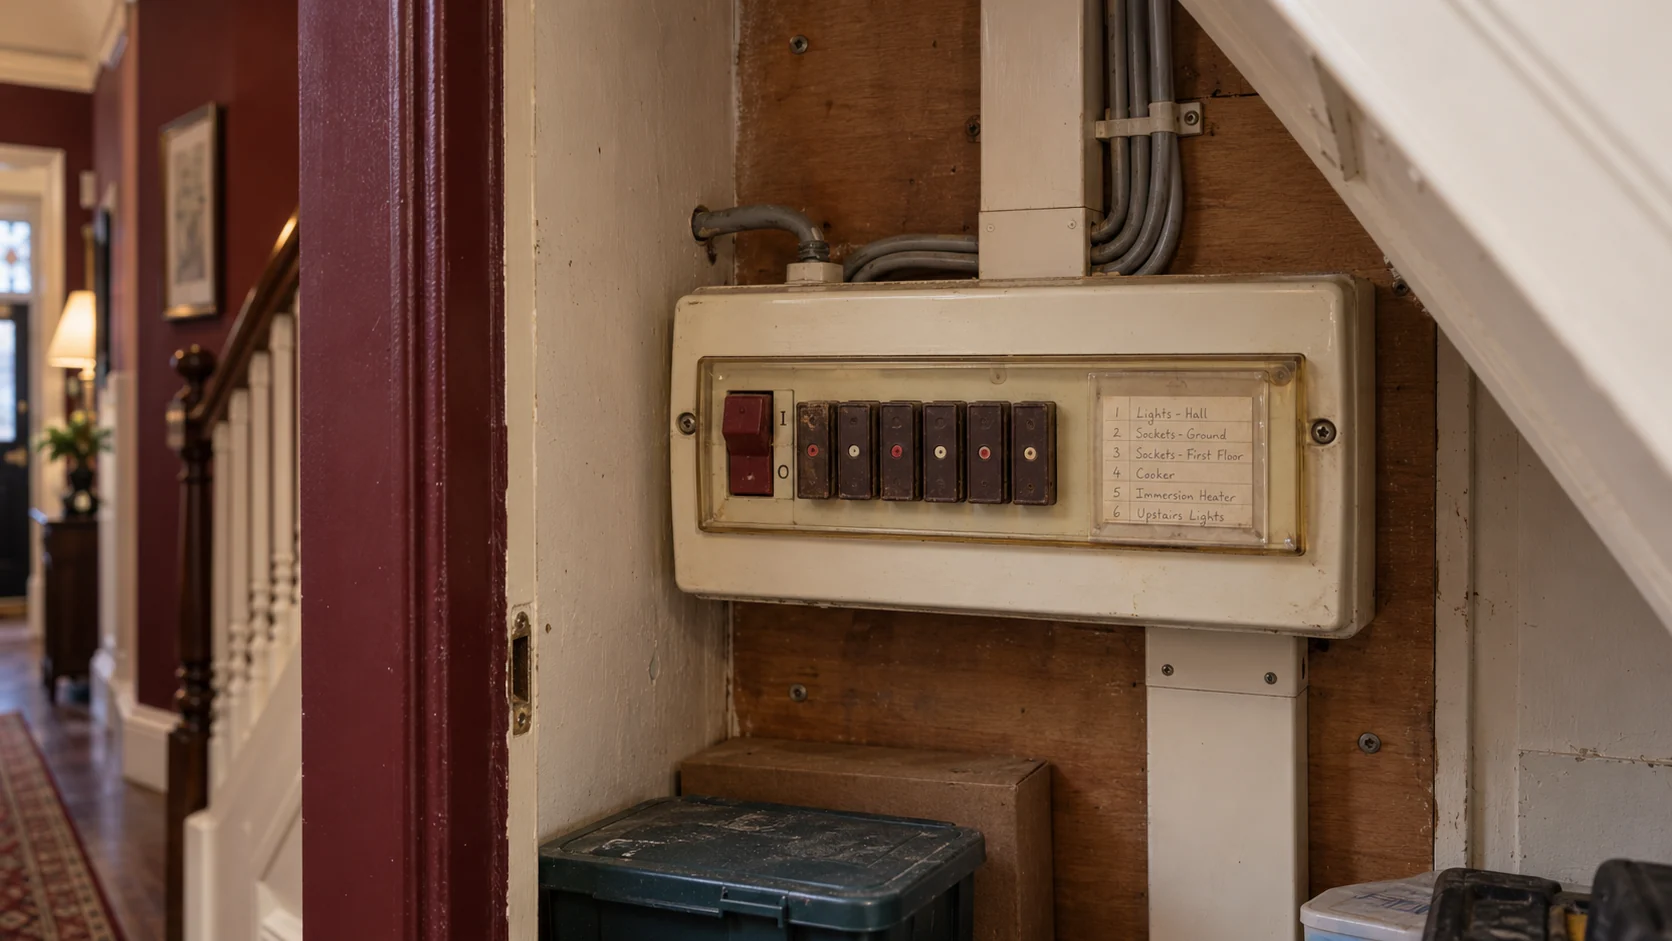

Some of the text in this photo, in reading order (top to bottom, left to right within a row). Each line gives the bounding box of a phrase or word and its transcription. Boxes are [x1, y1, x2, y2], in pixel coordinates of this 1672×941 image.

[1136, 407, 1172, 425] Lights
[1185, 408, 1208, 419] Hall
[1113, 428, 1122, 438] 2
[1135, 428, 1176, 440] Sockets
[1187, 429, 1227, 440] Ground
[1113, 447, 1121, 459] 3
[1136, 447, 1175, 460] Sockets
[1187, 449, 1212, 461] First
[1217, 449, 1245, 461] Floor
[1113, 467, 1176, 480] 4 Cooker
[1113, 487, 1236, 503] 5 Immersion Heater
[1113, 507, 1225, 527] 6 Upstairs Lights
